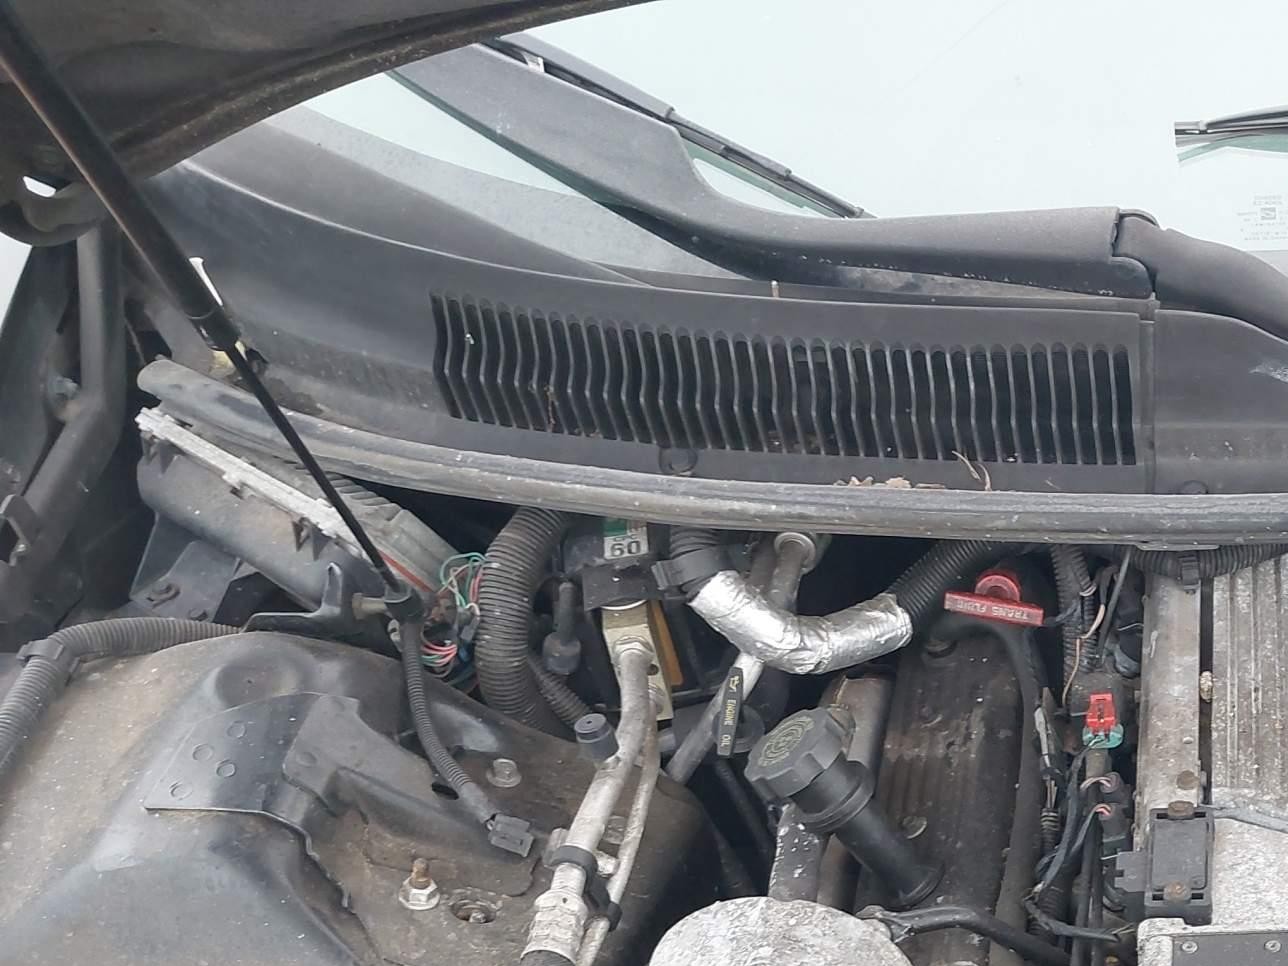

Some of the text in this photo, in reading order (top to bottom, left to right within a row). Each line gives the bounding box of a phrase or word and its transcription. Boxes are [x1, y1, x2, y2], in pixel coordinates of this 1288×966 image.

[992, 605, 1030, 622] TRANS
[724, 699, 737, 726] ENGINE
[720, 734, 731, 748] OIL
